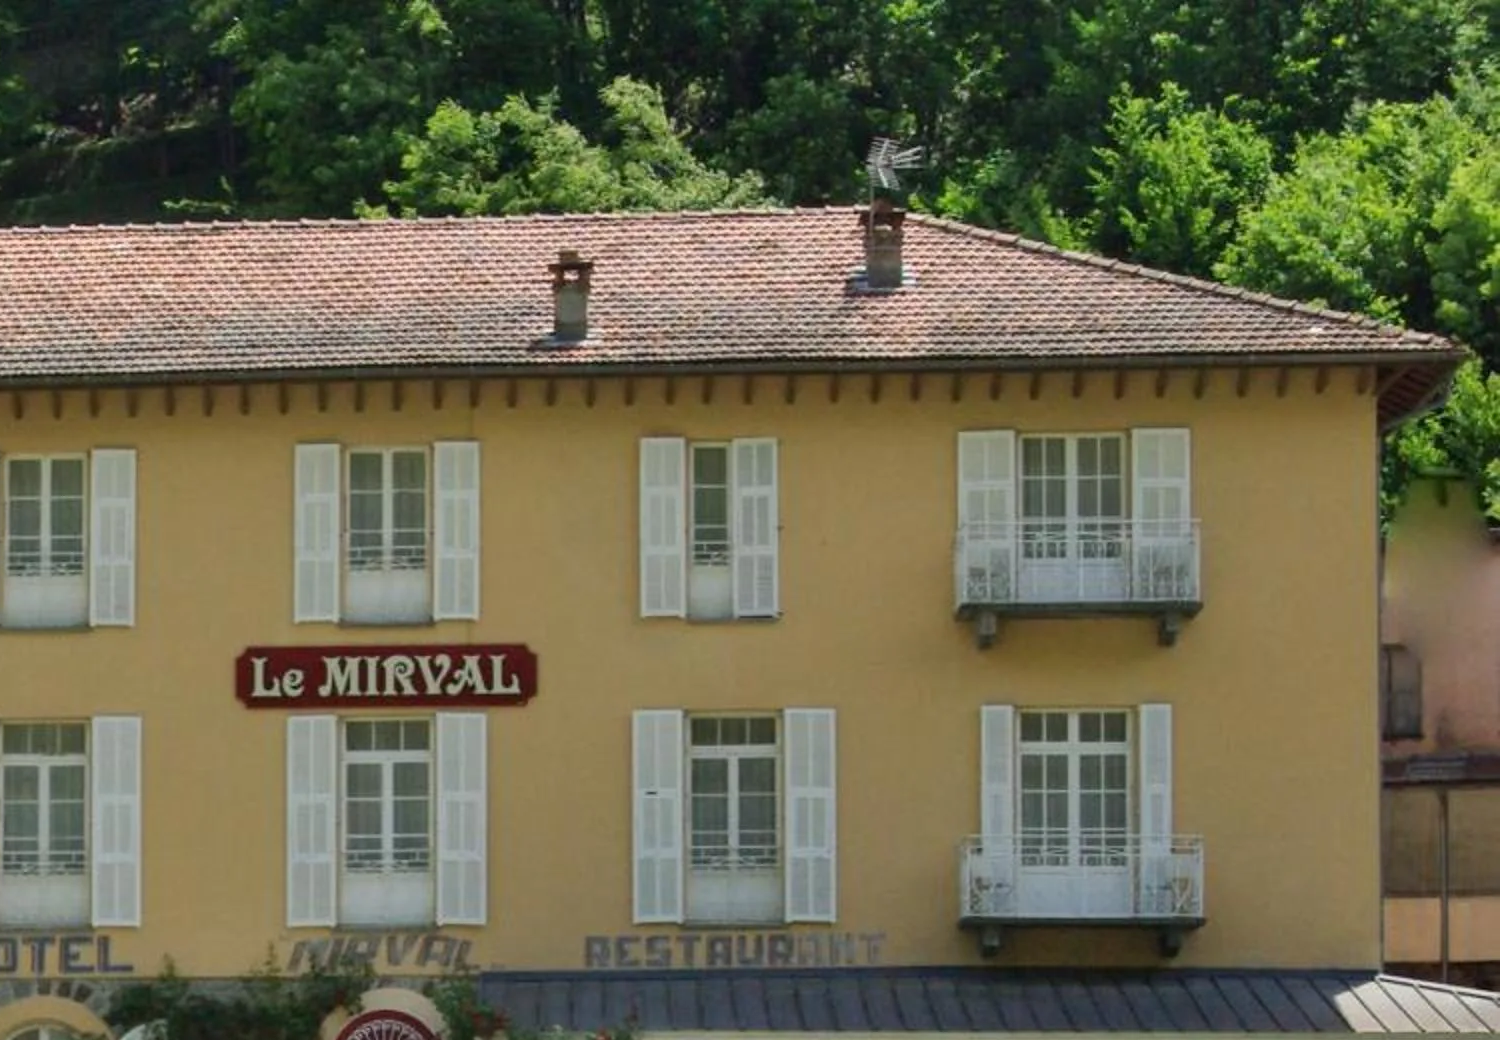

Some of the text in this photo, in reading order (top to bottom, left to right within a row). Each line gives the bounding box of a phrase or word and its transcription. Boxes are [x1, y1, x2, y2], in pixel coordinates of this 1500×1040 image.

[251, 653, 521, 697] Le MIRVAL
[585, 932, 887, 968] RESTAURANT
